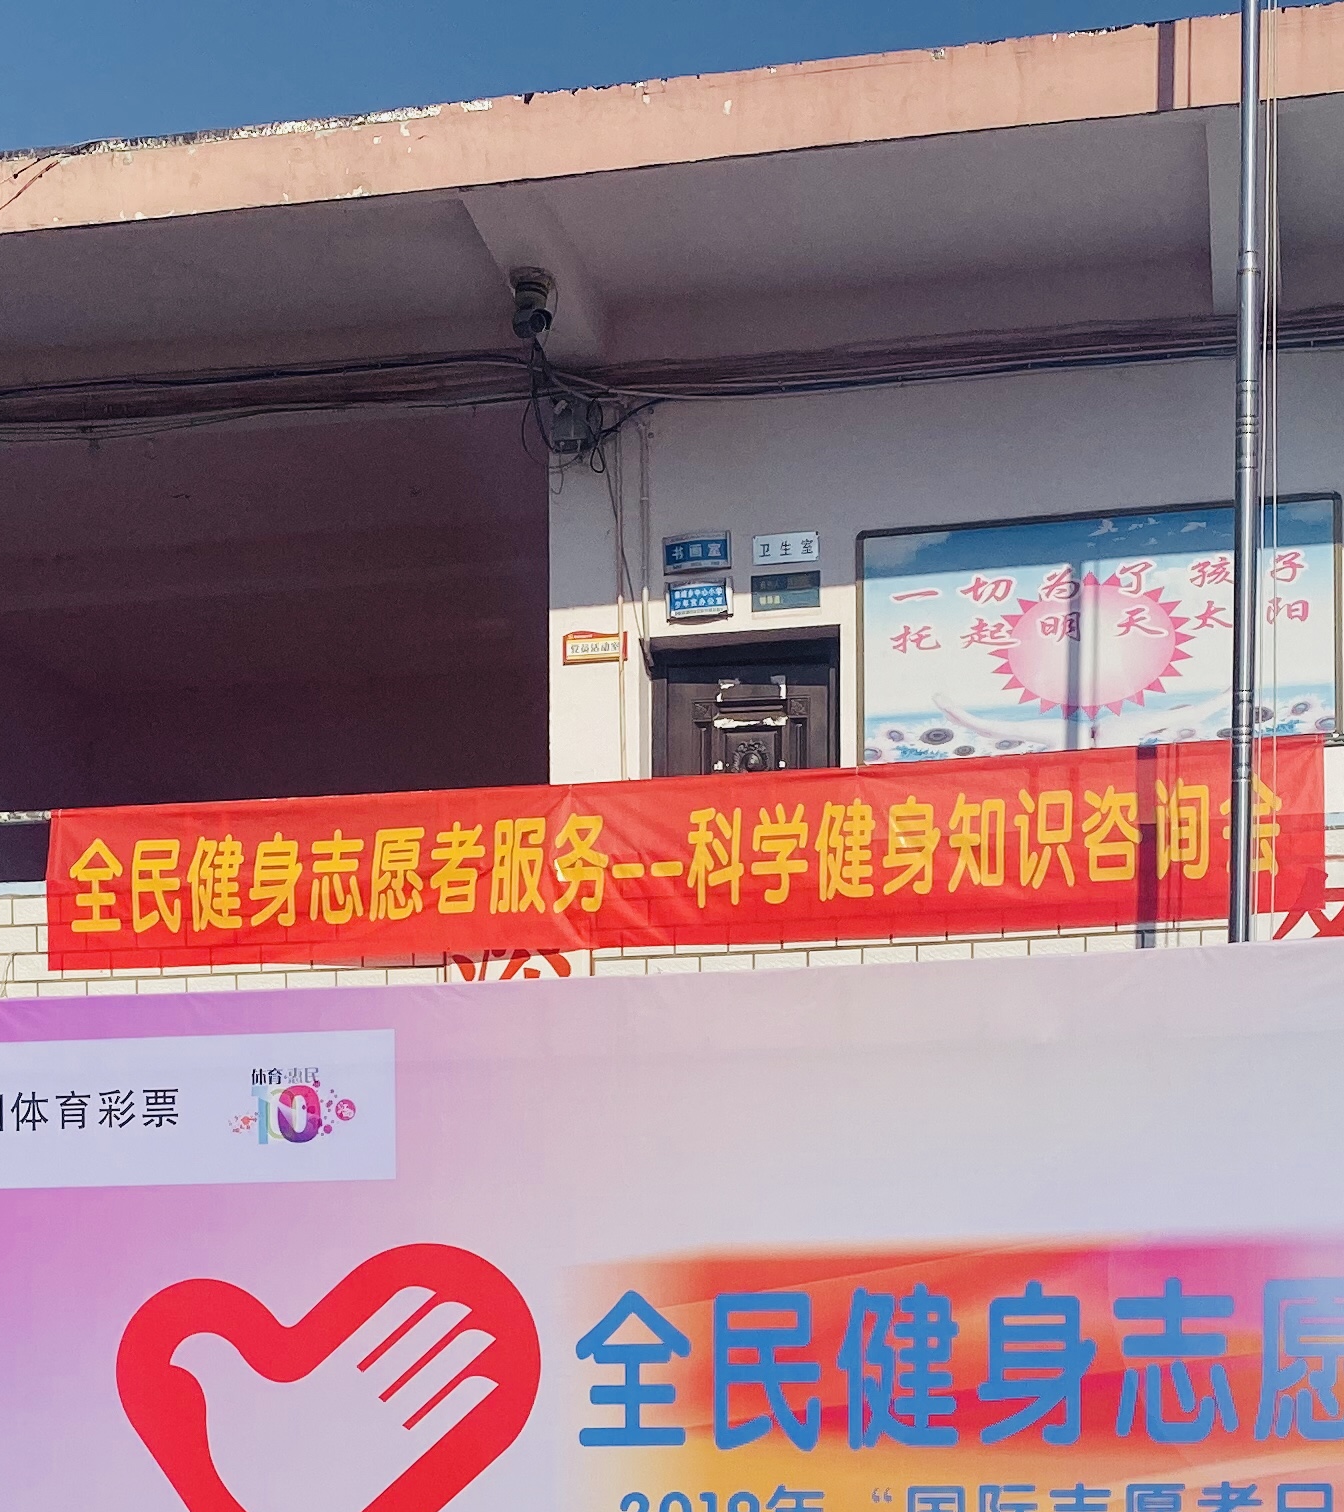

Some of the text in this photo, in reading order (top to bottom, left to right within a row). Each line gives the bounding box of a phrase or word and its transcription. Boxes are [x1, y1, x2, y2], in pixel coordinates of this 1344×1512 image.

[759, 538, 814, 558] 卫生室
[892, 551, 1306, 603] 一切为了孩子
[889, 596, 1310, 654] 托起明天太阳
